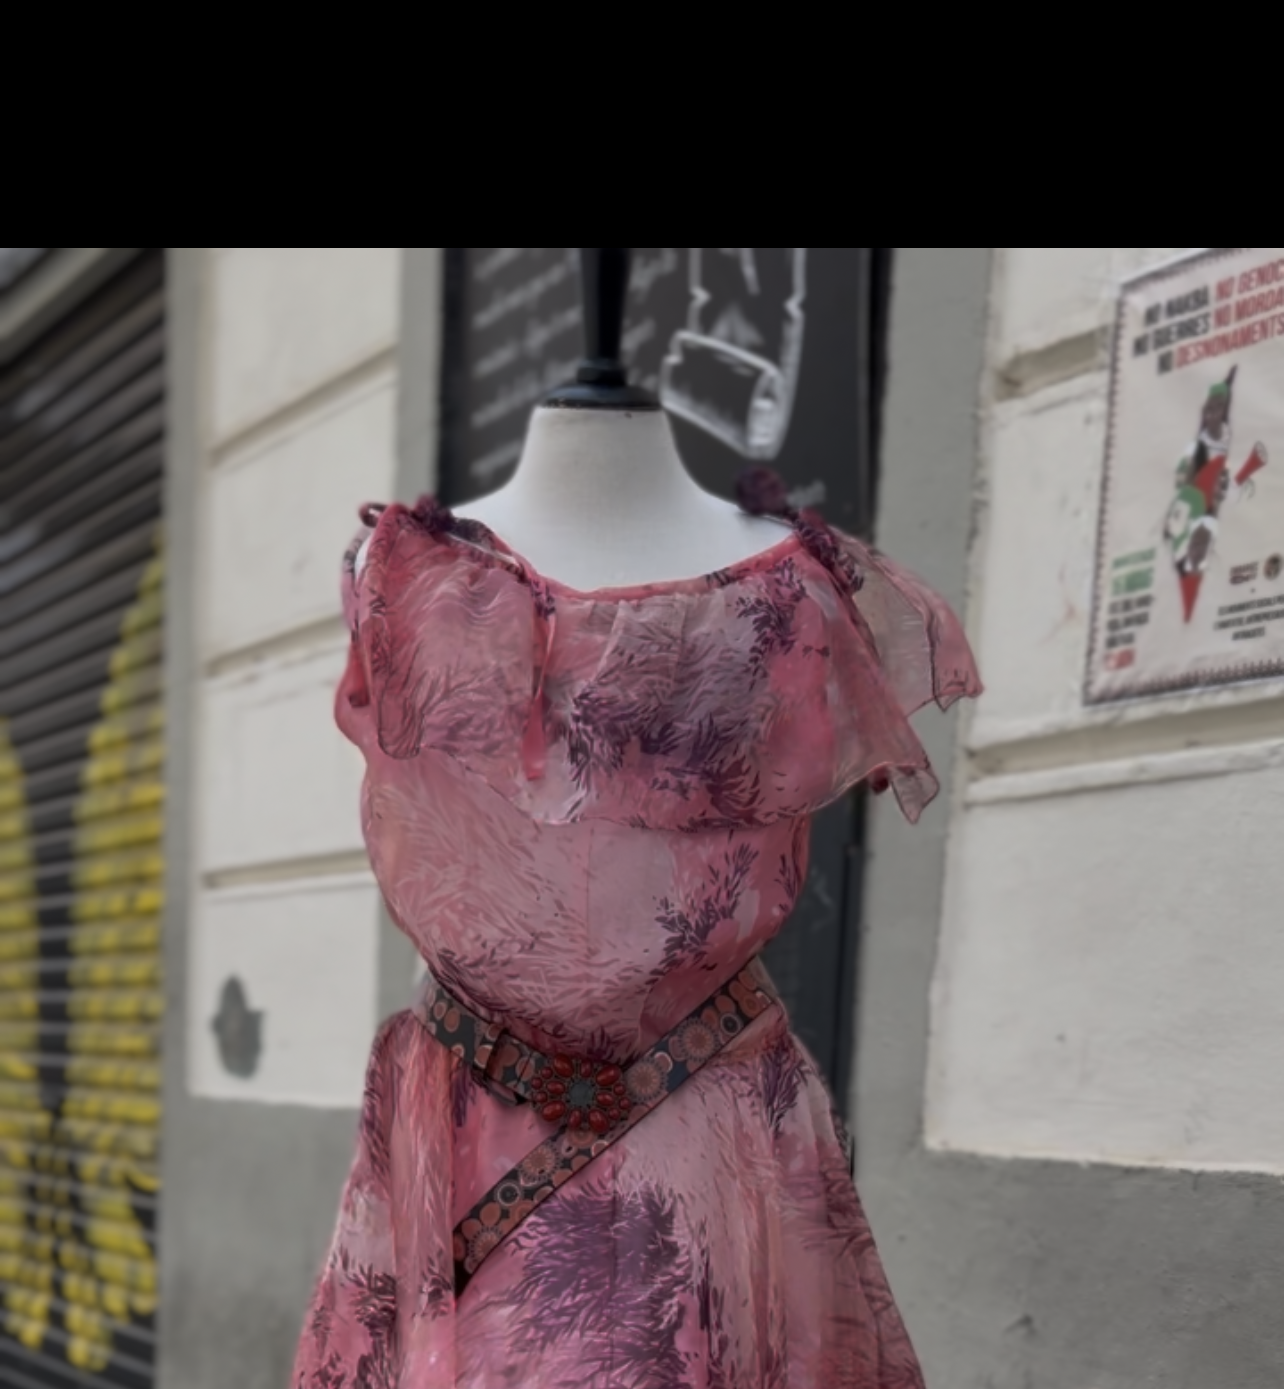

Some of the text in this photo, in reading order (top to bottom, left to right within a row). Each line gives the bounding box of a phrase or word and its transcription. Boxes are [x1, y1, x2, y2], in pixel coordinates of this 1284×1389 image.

[1144, 303, 1161, 326] NO
[1166, 285, 1209, 318] NAKBA
[1215, 277, 1235, 301] NO
[1133, 333, 1149, 358] NO
[1153, 312, 1210, 350] GUERRES
[1214, 304, 1231, 328] NO
[1157, 351, 1173, 375] NO
